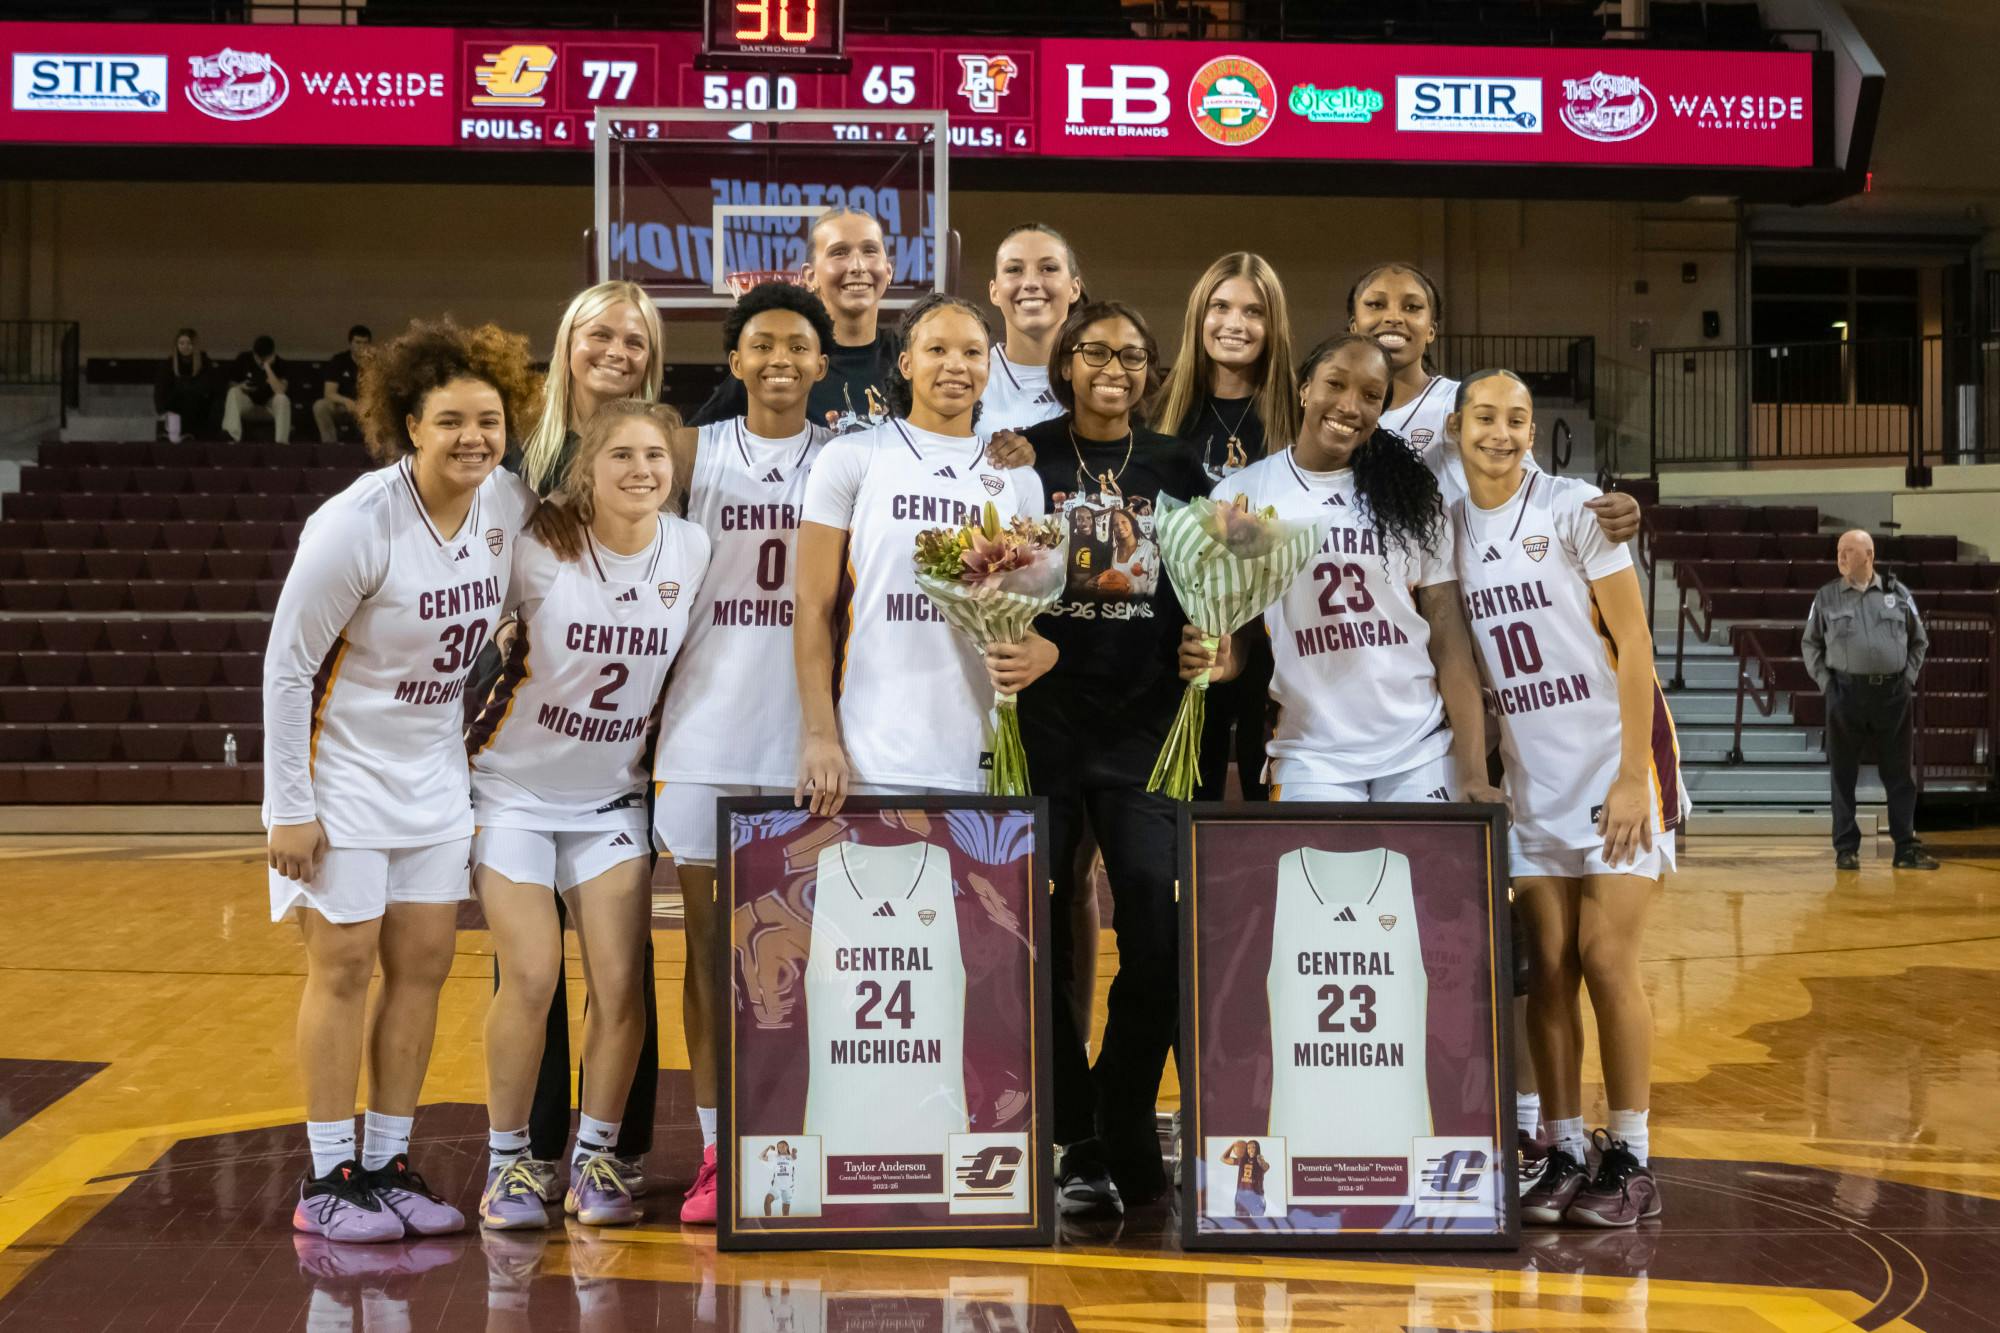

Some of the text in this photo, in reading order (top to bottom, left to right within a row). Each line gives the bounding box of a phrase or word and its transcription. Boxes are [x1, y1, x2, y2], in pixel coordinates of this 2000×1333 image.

[736, 0, 815, 41] 30
[740, 45, 806, 54] DAKTRONICS
[32, 60, 143, 93] STIR
[301, 71, 444, 97] WAYSIDE
[583, 60, 638, 100] 77
[704, 75, 797, 110] 5:00
[862, 66, 915, 104] 65
[1066, 64, 1171, 124] HB
[1415, 82, 1516, 114] STIR
[1669, 95, 1803, 119] WAYSIDE
[461, 119, 567, 139] FOULS: 4
[647, 123, 659, 138] 2
[1014, 128, 1027, 146] 4
[1698, 120, 1777, 129] NIGHTCLUB
[892, 494, 982, 527] CENTRA
[757, 538, 786, 591] 0
[419, 576, 502, 621] CENTRAL
[1312, 562, 1375, 616] 23
[712, 598, 794, 627] MICHIG
[433, 618, 489, 674] 30
[566, 622, 668, 656] CENTRAL
[1295, 620, 1409, 657] MICHIGAN
[1489, 621, 1543, 679] 10
[589, 662, 630, 712] 2
[1484, 673, 1591, 716] ICHIGAN
[537, 702, 649, 743] MICHIGAN
[835, 947, 933, 972] CENTRAL
[1297, 952, 1395, 976] CENTRAL
[855, 980, 916, 1030] 24
[1317, 984, 1377, 1033] 23
[831, 1039, 941, 1065] MICHIGAN
[1294, 1043, 1404, 1067] MICHIGAN
[844, 1160, 926, 1175] Taylor Anderson
[1297, 1163, 1332, 1172] Demetria
[1375, 1163, 1403, 1172] Prewitt
